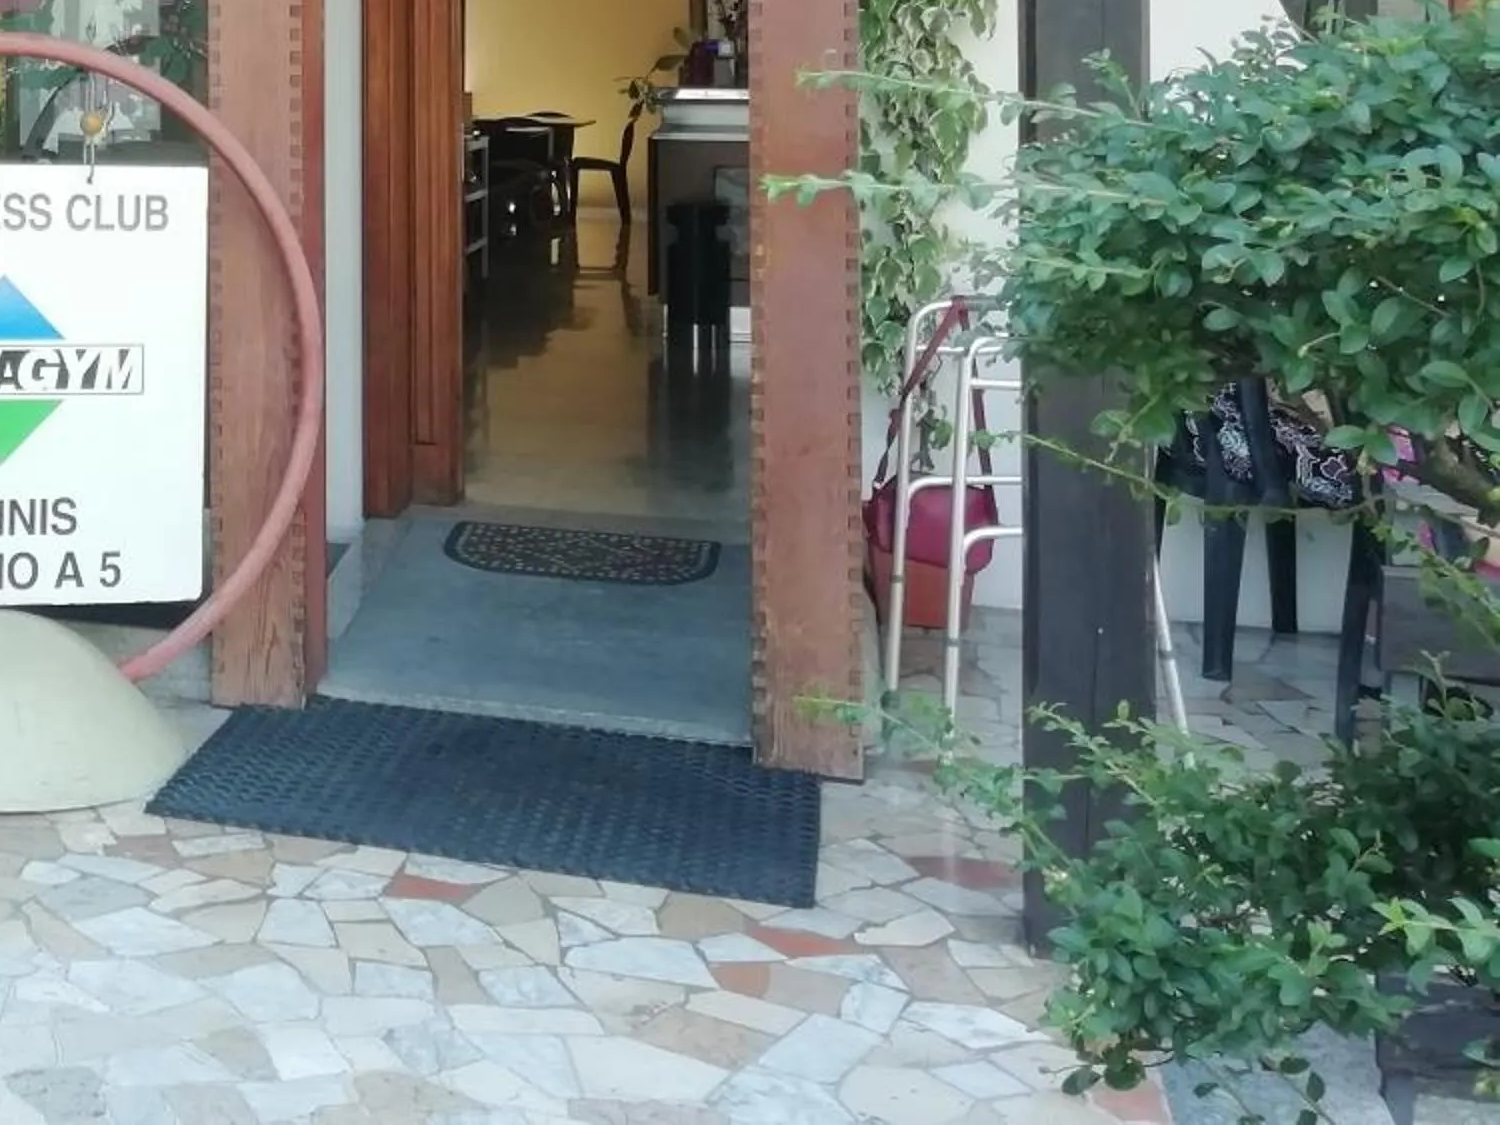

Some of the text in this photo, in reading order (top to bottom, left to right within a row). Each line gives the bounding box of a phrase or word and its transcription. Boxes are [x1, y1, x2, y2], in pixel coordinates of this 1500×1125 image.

[65, 193, 170, 232] CLUB
[55, 551, 85, 589] A
[99, 550, 122, 588] 5
